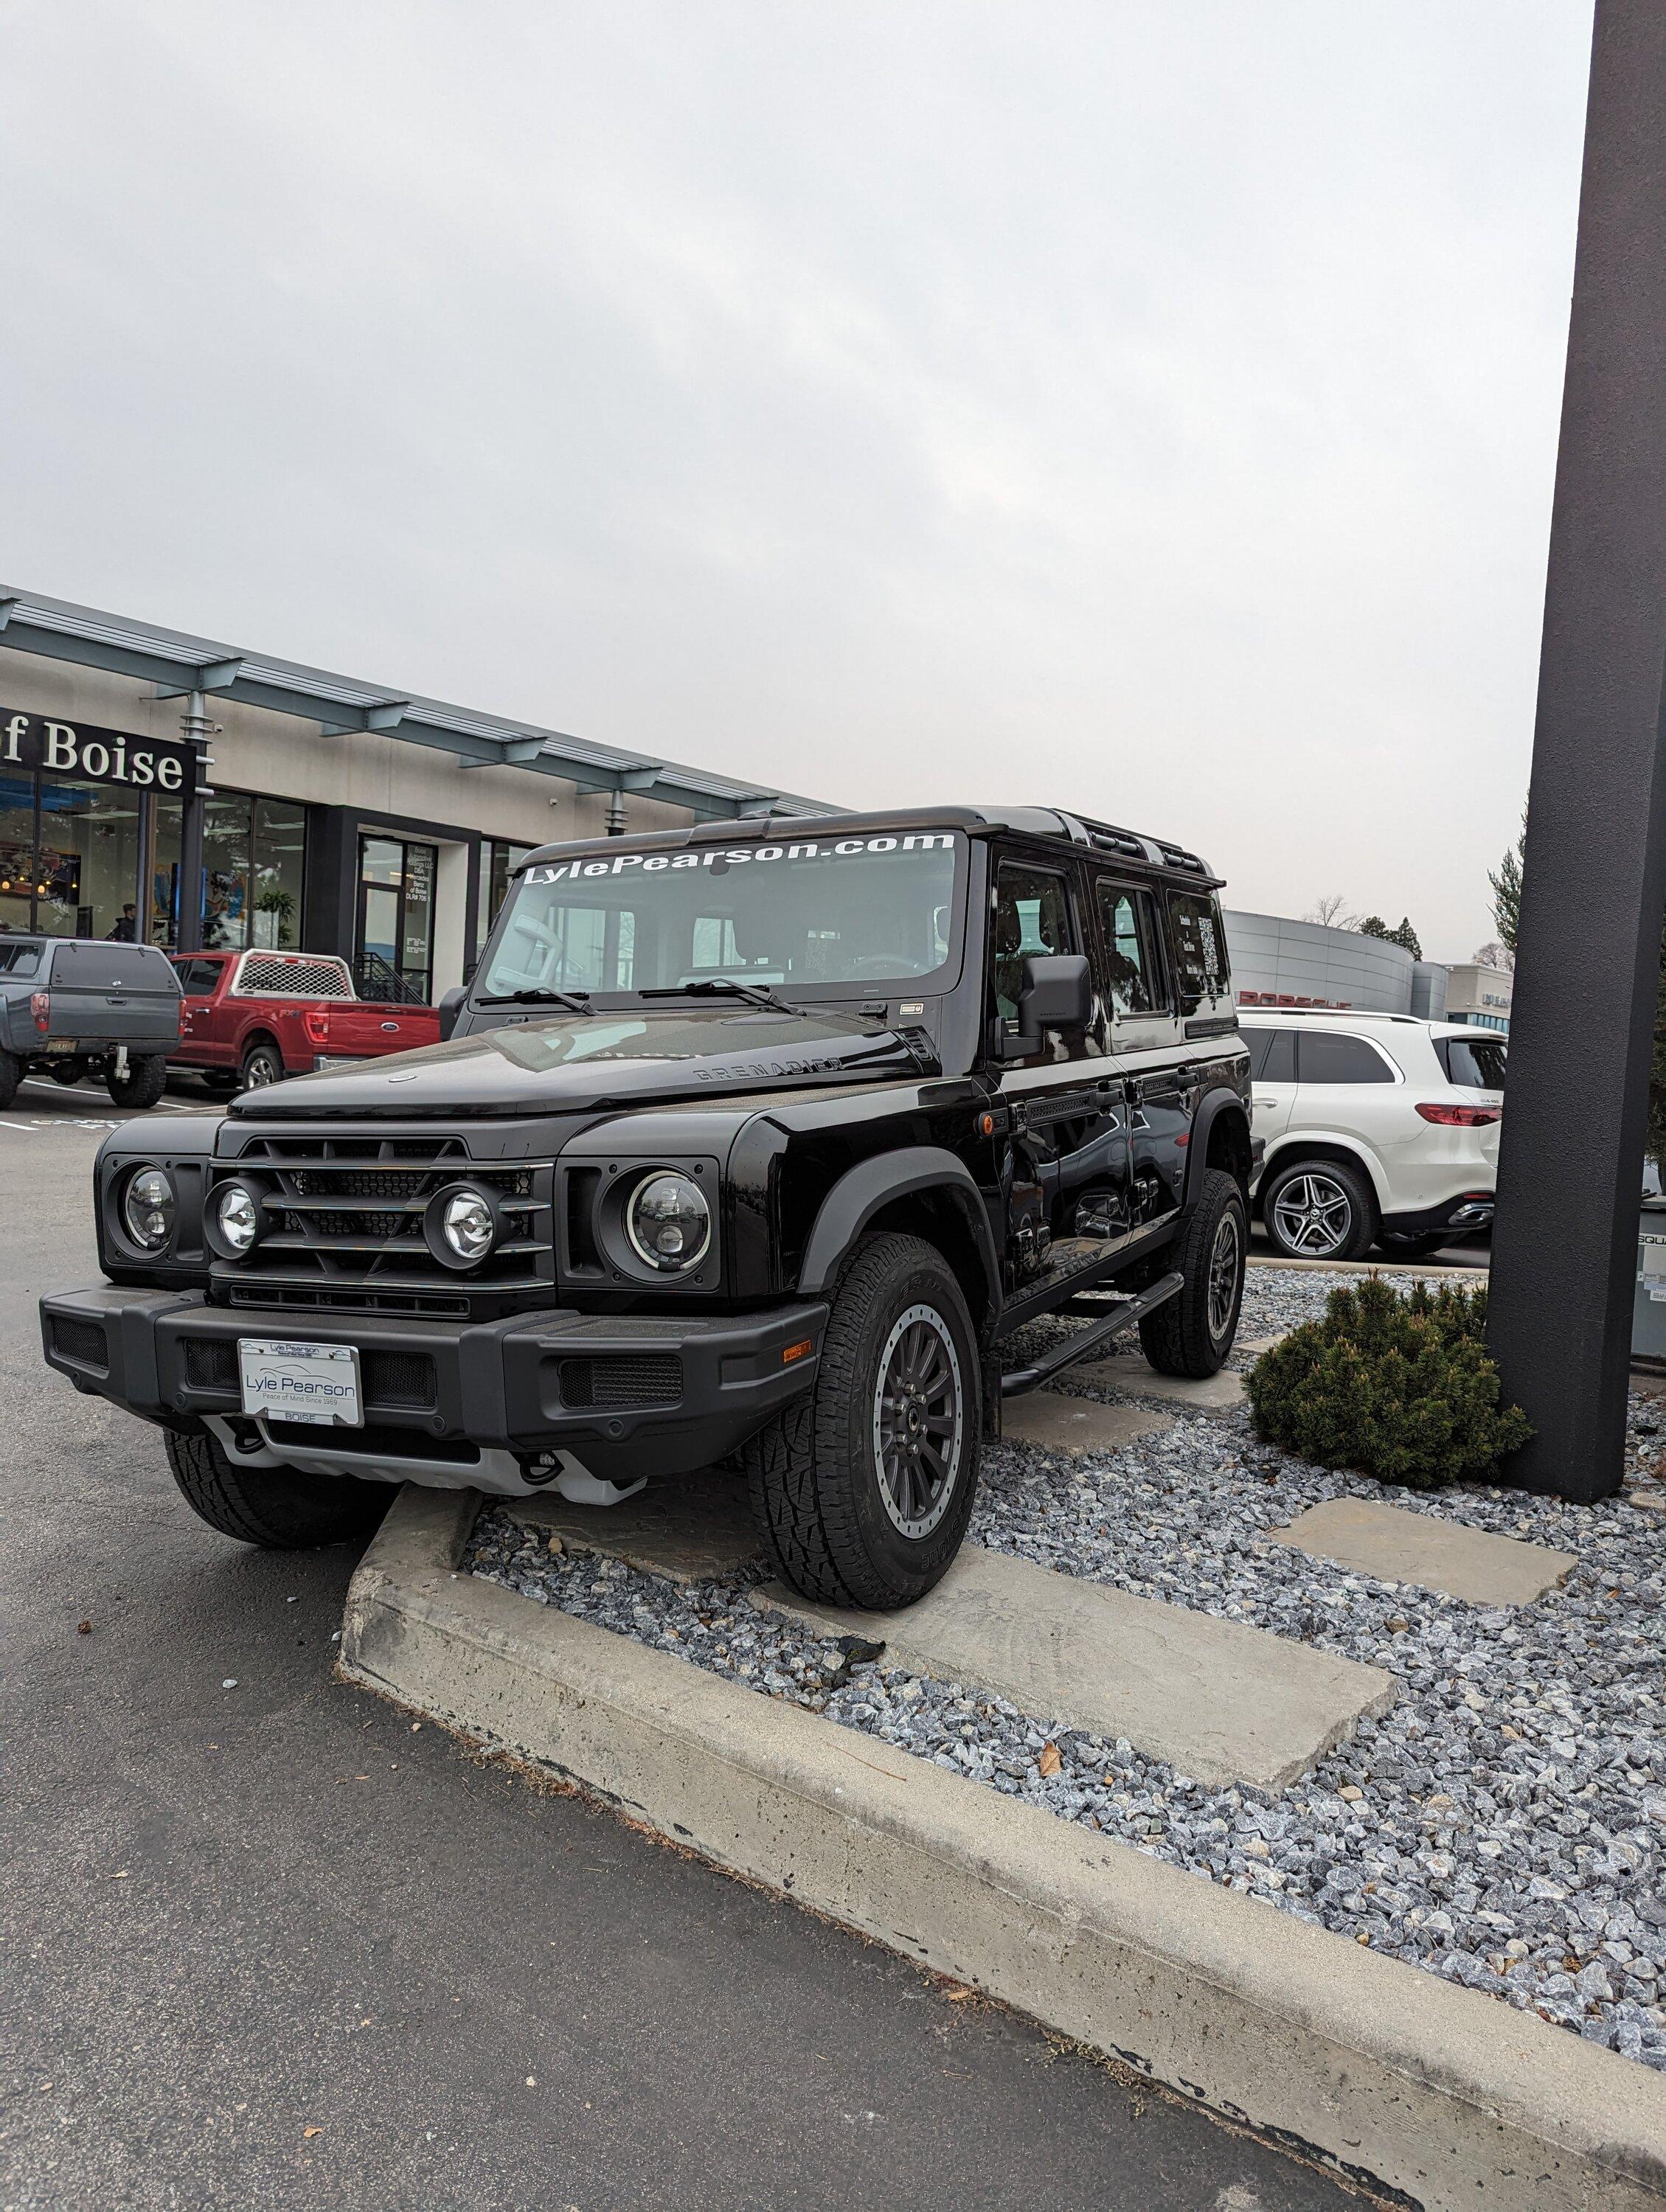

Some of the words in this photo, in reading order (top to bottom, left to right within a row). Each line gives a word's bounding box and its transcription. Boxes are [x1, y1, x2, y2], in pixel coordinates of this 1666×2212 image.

[3, 716, 29, 762] f
[41, 721, 183, 790] Boise
[524, 835, 955, 885] LylePearson.com
[693, 1057, 845, 1081] GRENADIER
[1637, 1235, 1666, 1245] SQU
[270, 1343, 285, 1352] Lyle
[285, 1344, 319, 1353] Pearson
[246, 1375, 277, 1392] Lyle
[282, 1377, 355, 1397] Pearson
[285, 1412, 316, 1423] BOISE
